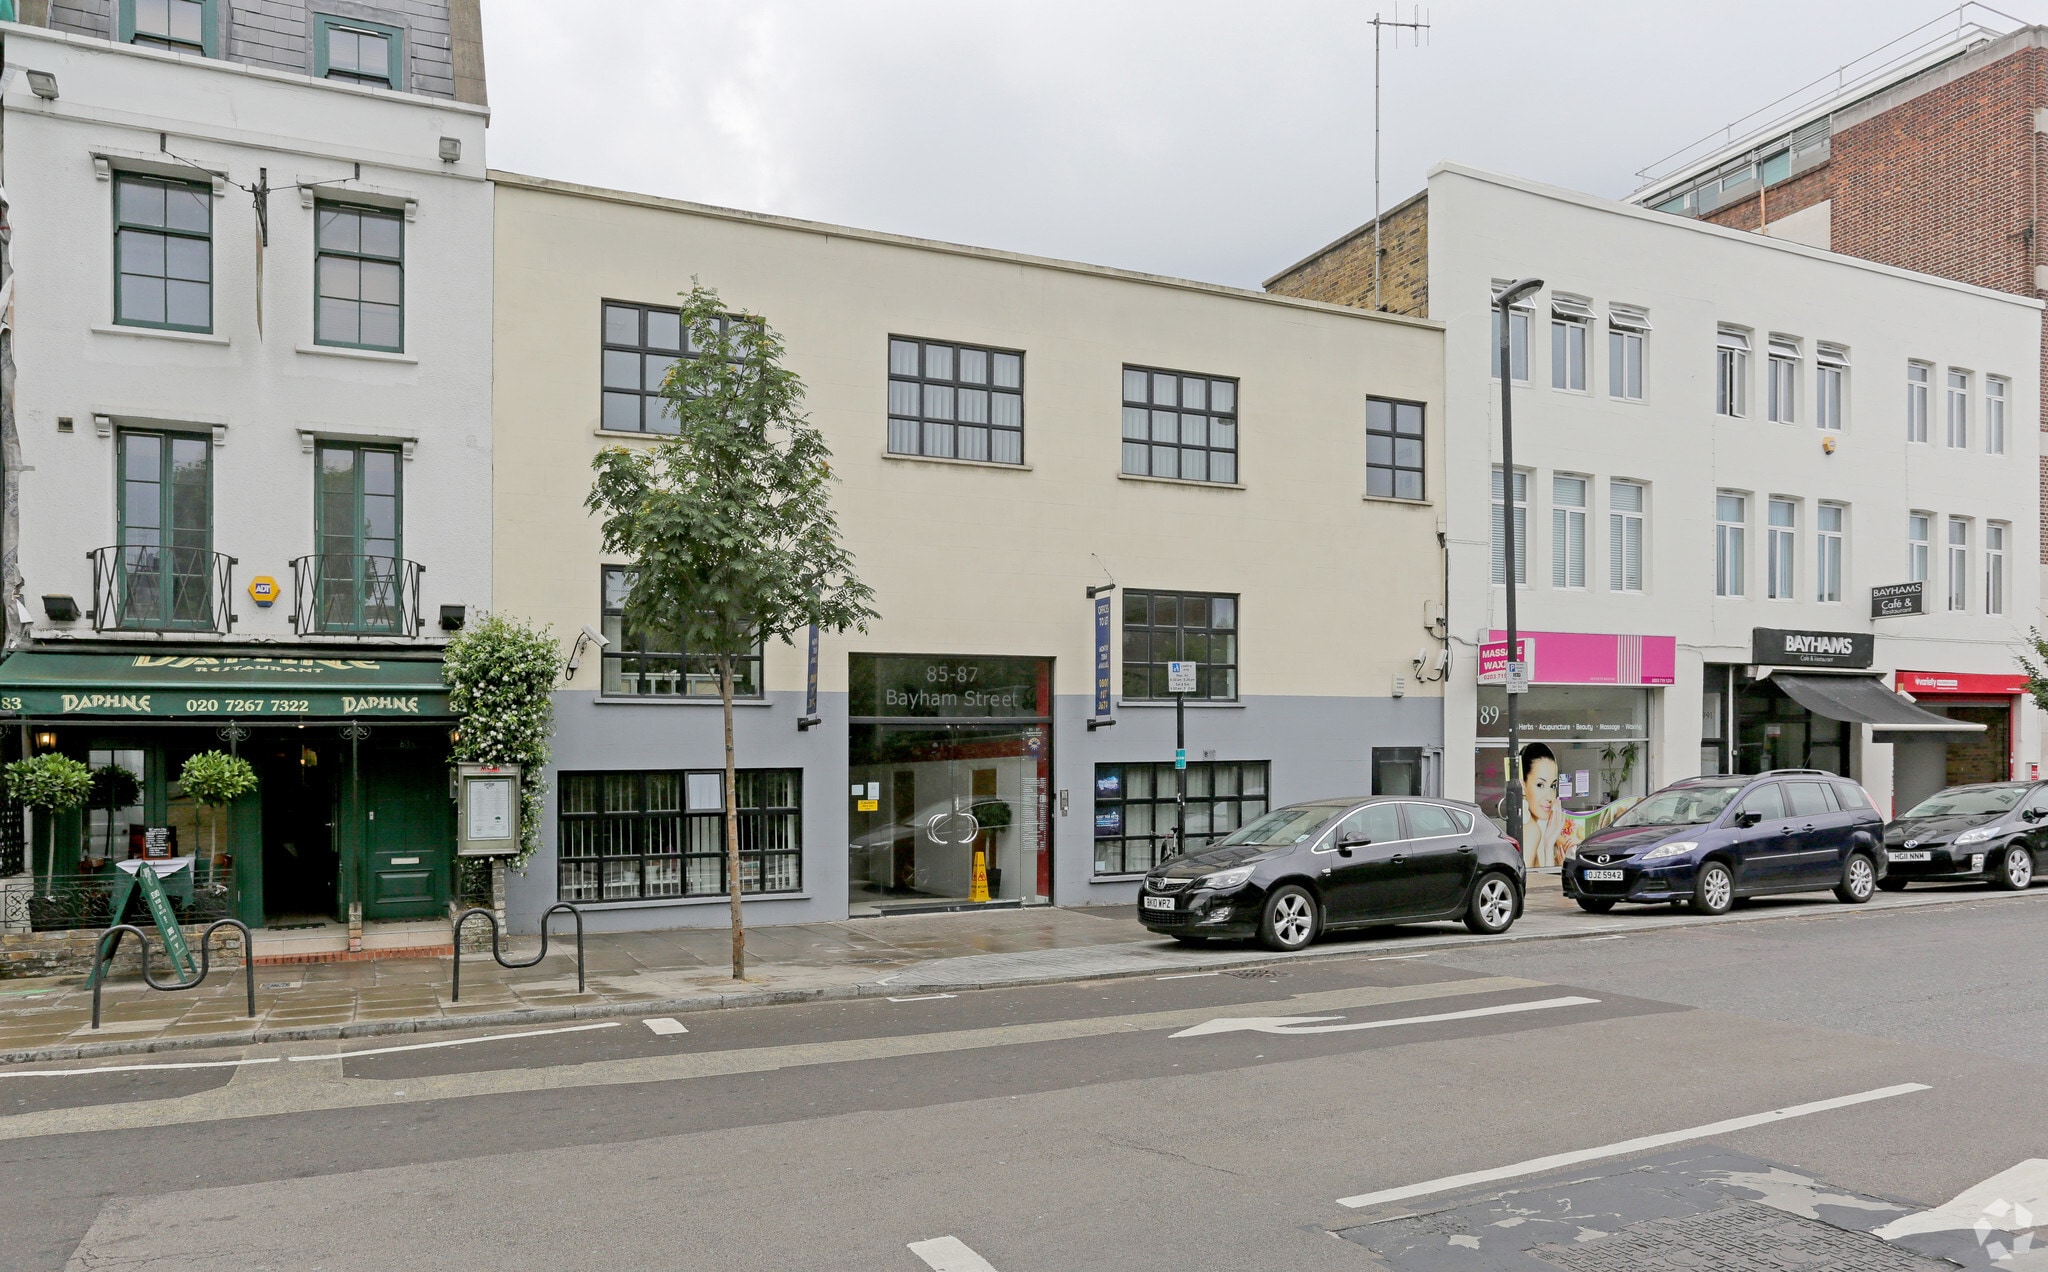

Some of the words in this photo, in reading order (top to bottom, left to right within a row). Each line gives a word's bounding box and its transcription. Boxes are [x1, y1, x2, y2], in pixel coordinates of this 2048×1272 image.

[256, 585, 270, 593] ADT
[1873, 584, 1921, 597] BAYHAMS
[1904, 598, 1912, 607] &
[1785, 635, 1852, 654] BAYHAMS
[1482, 646, 1523, 659] MASSE
[195, 665, 324, 673] RESTAURANT
[927, 666, 978, 683] 85-87
[2, 697, 22, 710] 83
[61, 694, 151, 713] DAPHNE
[186, 699, 218, 712] 020
[225, 700, 263, 712] 7267
[270, 700, 309, 712] 7322
[341, 696, 418, 714] DAPHNE
[886, 689, 957, 709] Bayham
[964, 690, 1018, 707] Street
[1480, 705, 1499, 725] 89
[1539, 723, 1571, 732] Acupuncture
[1575, 723, 1594, 732] Beauty
[1599, 724, 1620, 732] Massage
[1603, 871, 1622, 880] 5942
